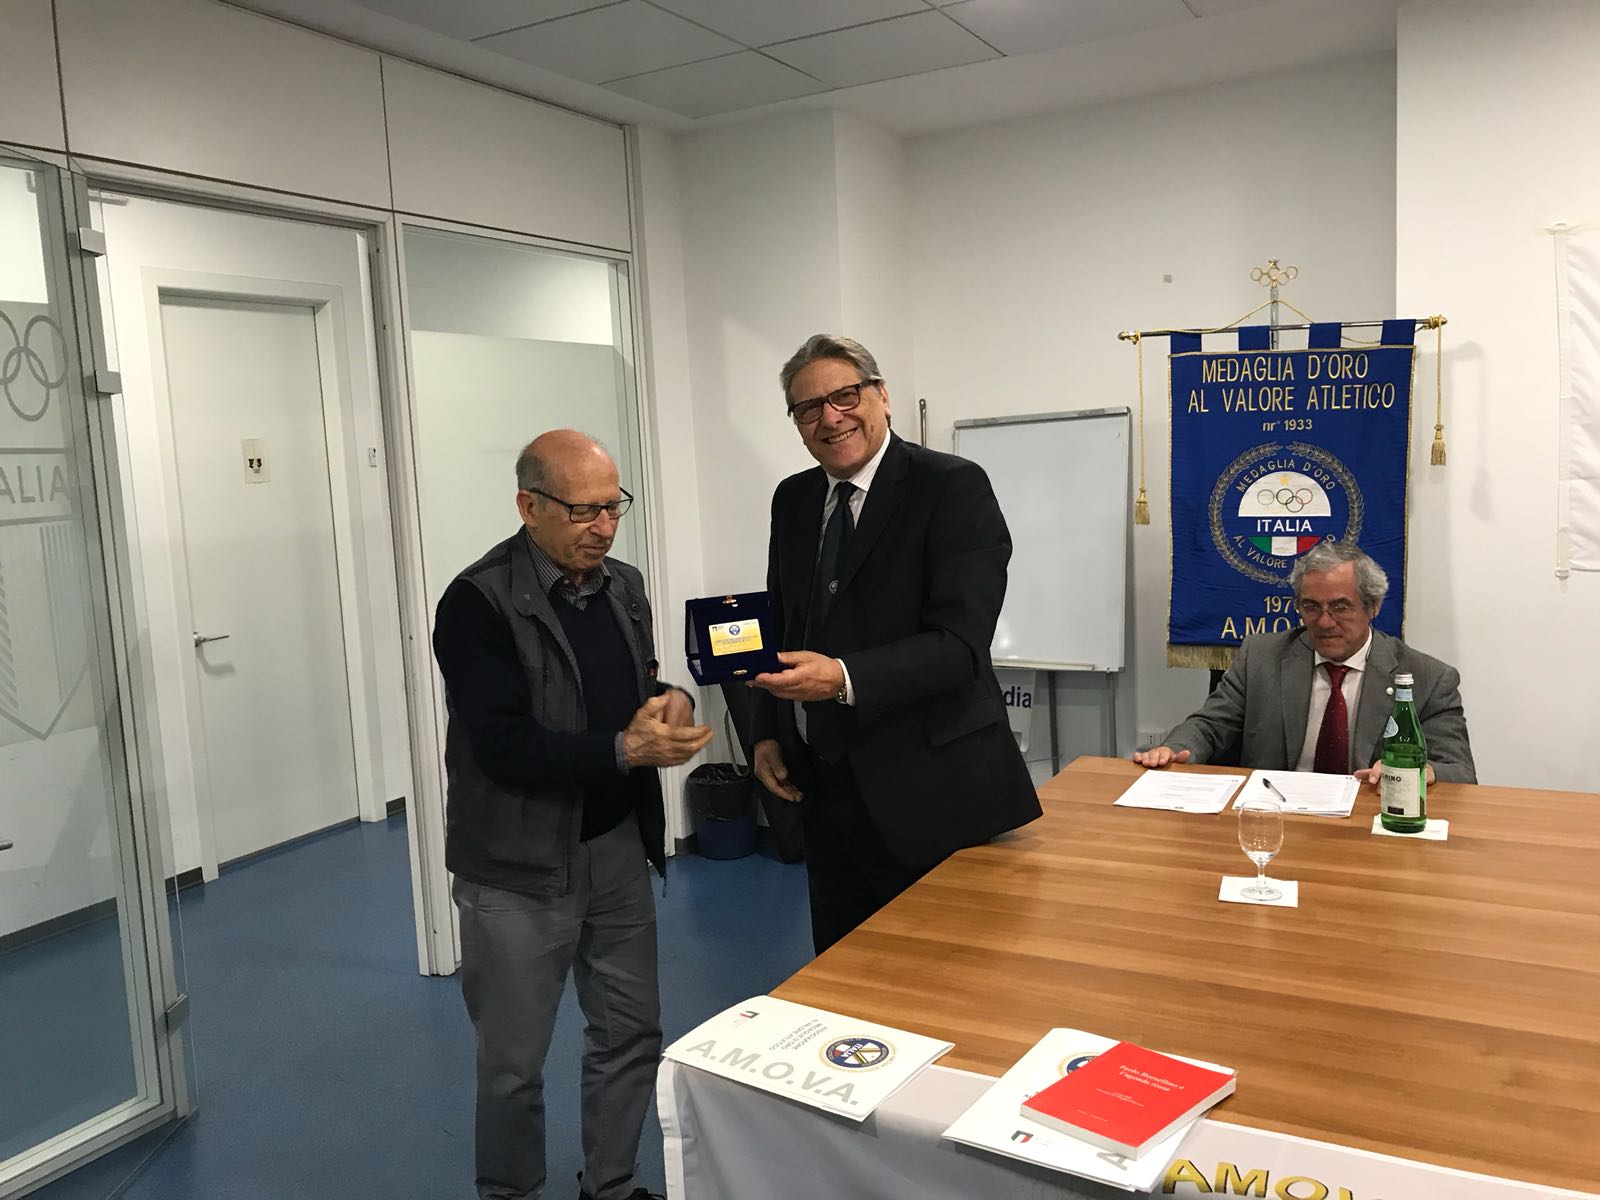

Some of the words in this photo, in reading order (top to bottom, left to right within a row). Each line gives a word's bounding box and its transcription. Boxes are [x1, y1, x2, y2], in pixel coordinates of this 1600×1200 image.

[1202, 356, 1295, 383] MEDAGLIA
[1307, 354, 1369, 380] D'ORO
[1188, 389, 1209, 413] AL
[1222, 386, 1295, 412] VALORE
[1306, 383, 1396, 411] ATLETICO
[1284, 418, 1313, 431] 1933
[1236, 459, 1296, 493] MEDAGLIA
[1302, 461, 1336, 490] D'ORO
[1257, 519, 1313, 533] ITALIA
[1233, 534, 1246, 549] AL
[1246, 546, 1288, 569] VALORE
[1263, 595, 1300, 614] 197
[685, 1039, 858, 1105] A.M.O.V.A.
[1162, 1158, 1354, 1200] AMO
